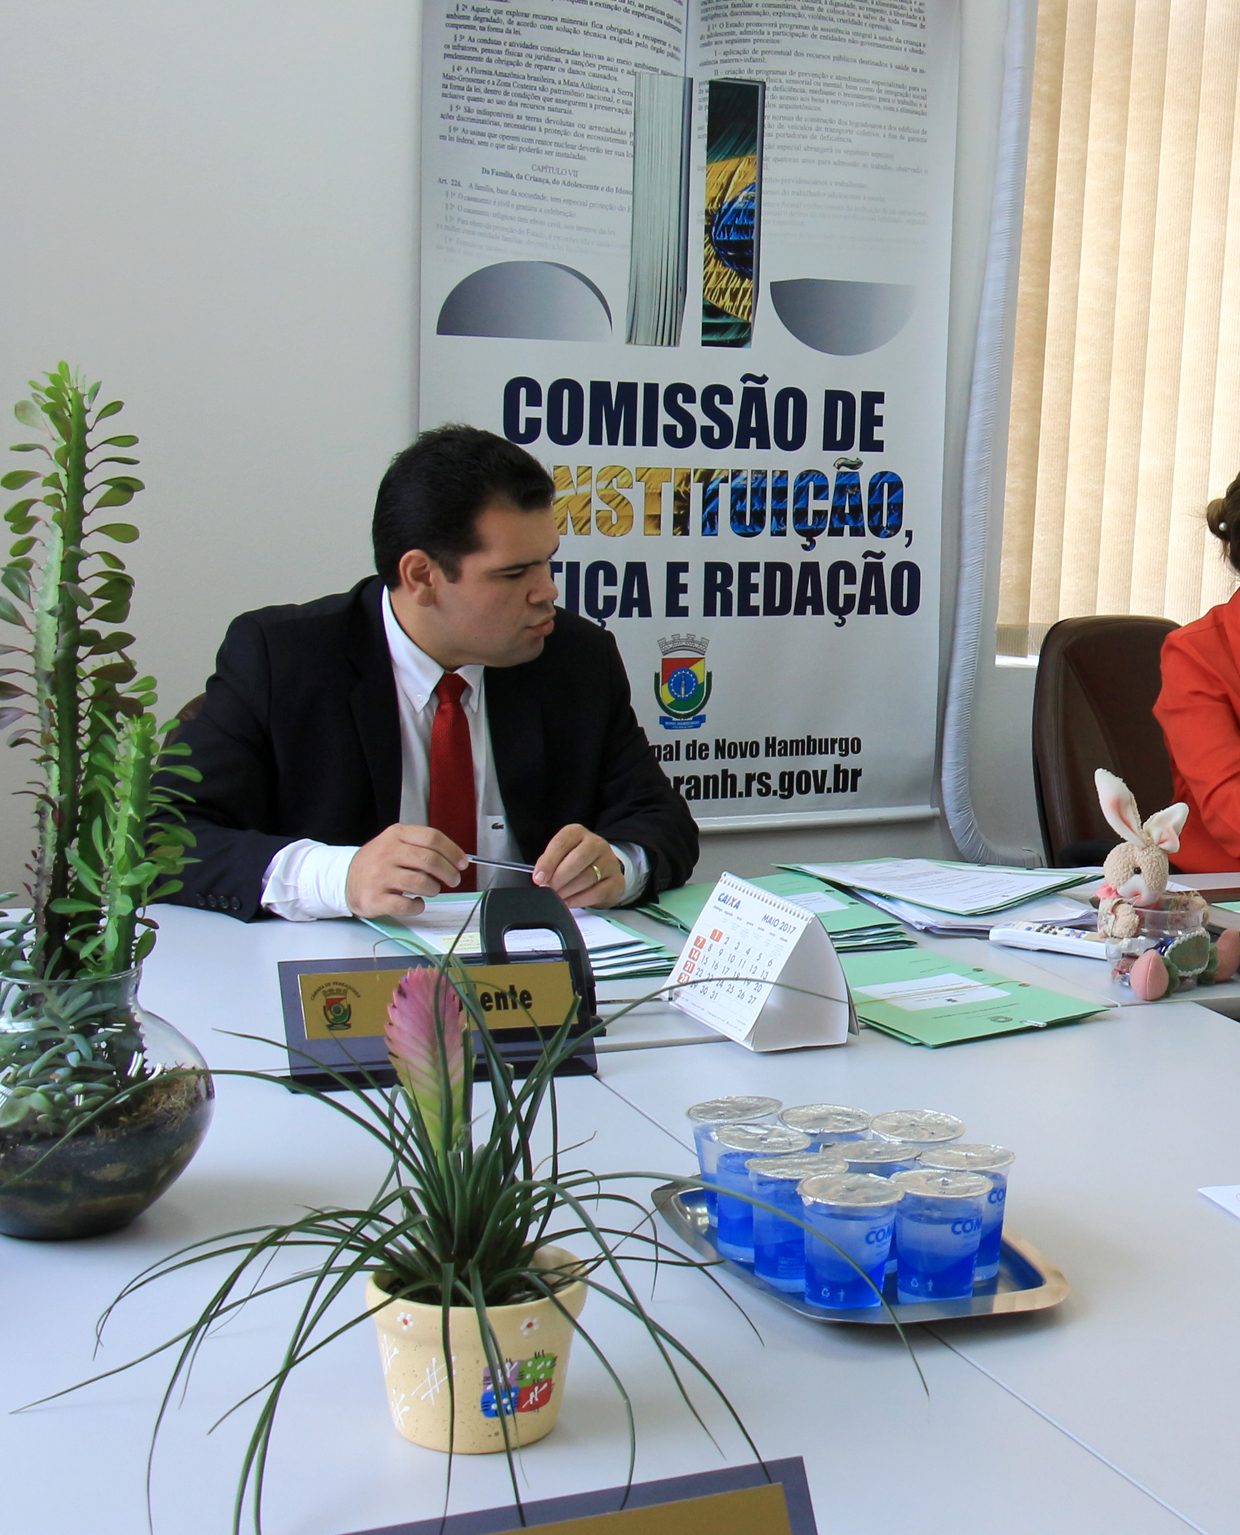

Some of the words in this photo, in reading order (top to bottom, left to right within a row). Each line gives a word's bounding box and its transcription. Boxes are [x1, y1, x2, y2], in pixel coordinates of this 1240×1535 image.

[503, 372, 807, 451] COMISSÃO
[822, 390, 885, 452] DE
[553, 457, 912, 550] NSTITUIÇÃO,
[665, 561, 689, 617] E
[702, 550, 921, 627] REDAÇÃO
[650, 740, 680, 762] pal
[685, 740, 709, 761] de
[714, 738, 760, 759] Novo
[765, 735, 862, 757] Hamburgo
[671, 764, 862, 800] ranh.rs.gov.br
[718, 892, 741, 909] CAIXA
[761, 913, 779, 927] MAIO
[779, 921, 797, 935] 2017
[691, 950, 699, 959] 14
[701, 955, 709, 965] 15
[712, 960, 719, 970] 16
[722, 966, 730, 975] 17
[754, 981, 762, 992] 20
[727, 953, 735, 963] 10
[738, 959, 746, 968] 11
[749, 964, 757, 974] 12
[760, 970, 768, 980] 13
[473, 984, 532, 1012] ente
[686, 963, 694, 972] 21
[695, 967, 704, 977] 22
[727, 984, 735, 994] 25
[737, 990, 745, 999] 26
[747, 995, 757, 1004] 27
[700, 985, 708, 995] 30
[710, 991, 718, 1000] 31
